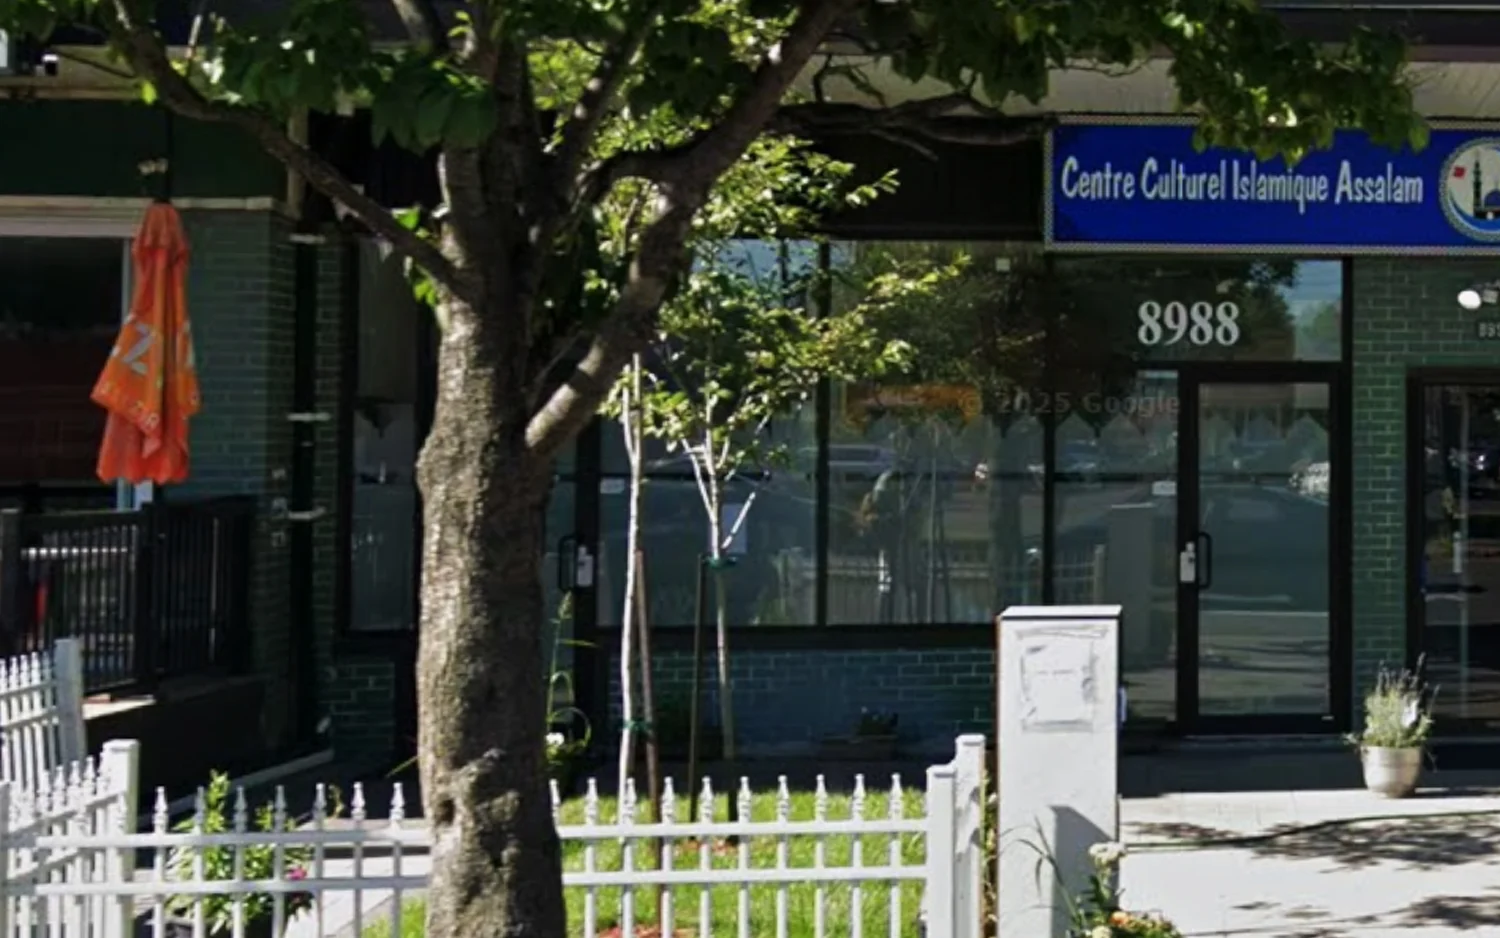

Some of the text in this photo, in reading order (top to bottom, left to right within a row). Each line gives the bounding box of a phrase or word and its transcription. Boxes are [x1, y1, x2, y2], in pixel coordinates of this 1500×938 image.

[1062, 155, 1424, 215] Centre Culturel Islamique Assalam
[1138, 301, 1240, 346] 8988
